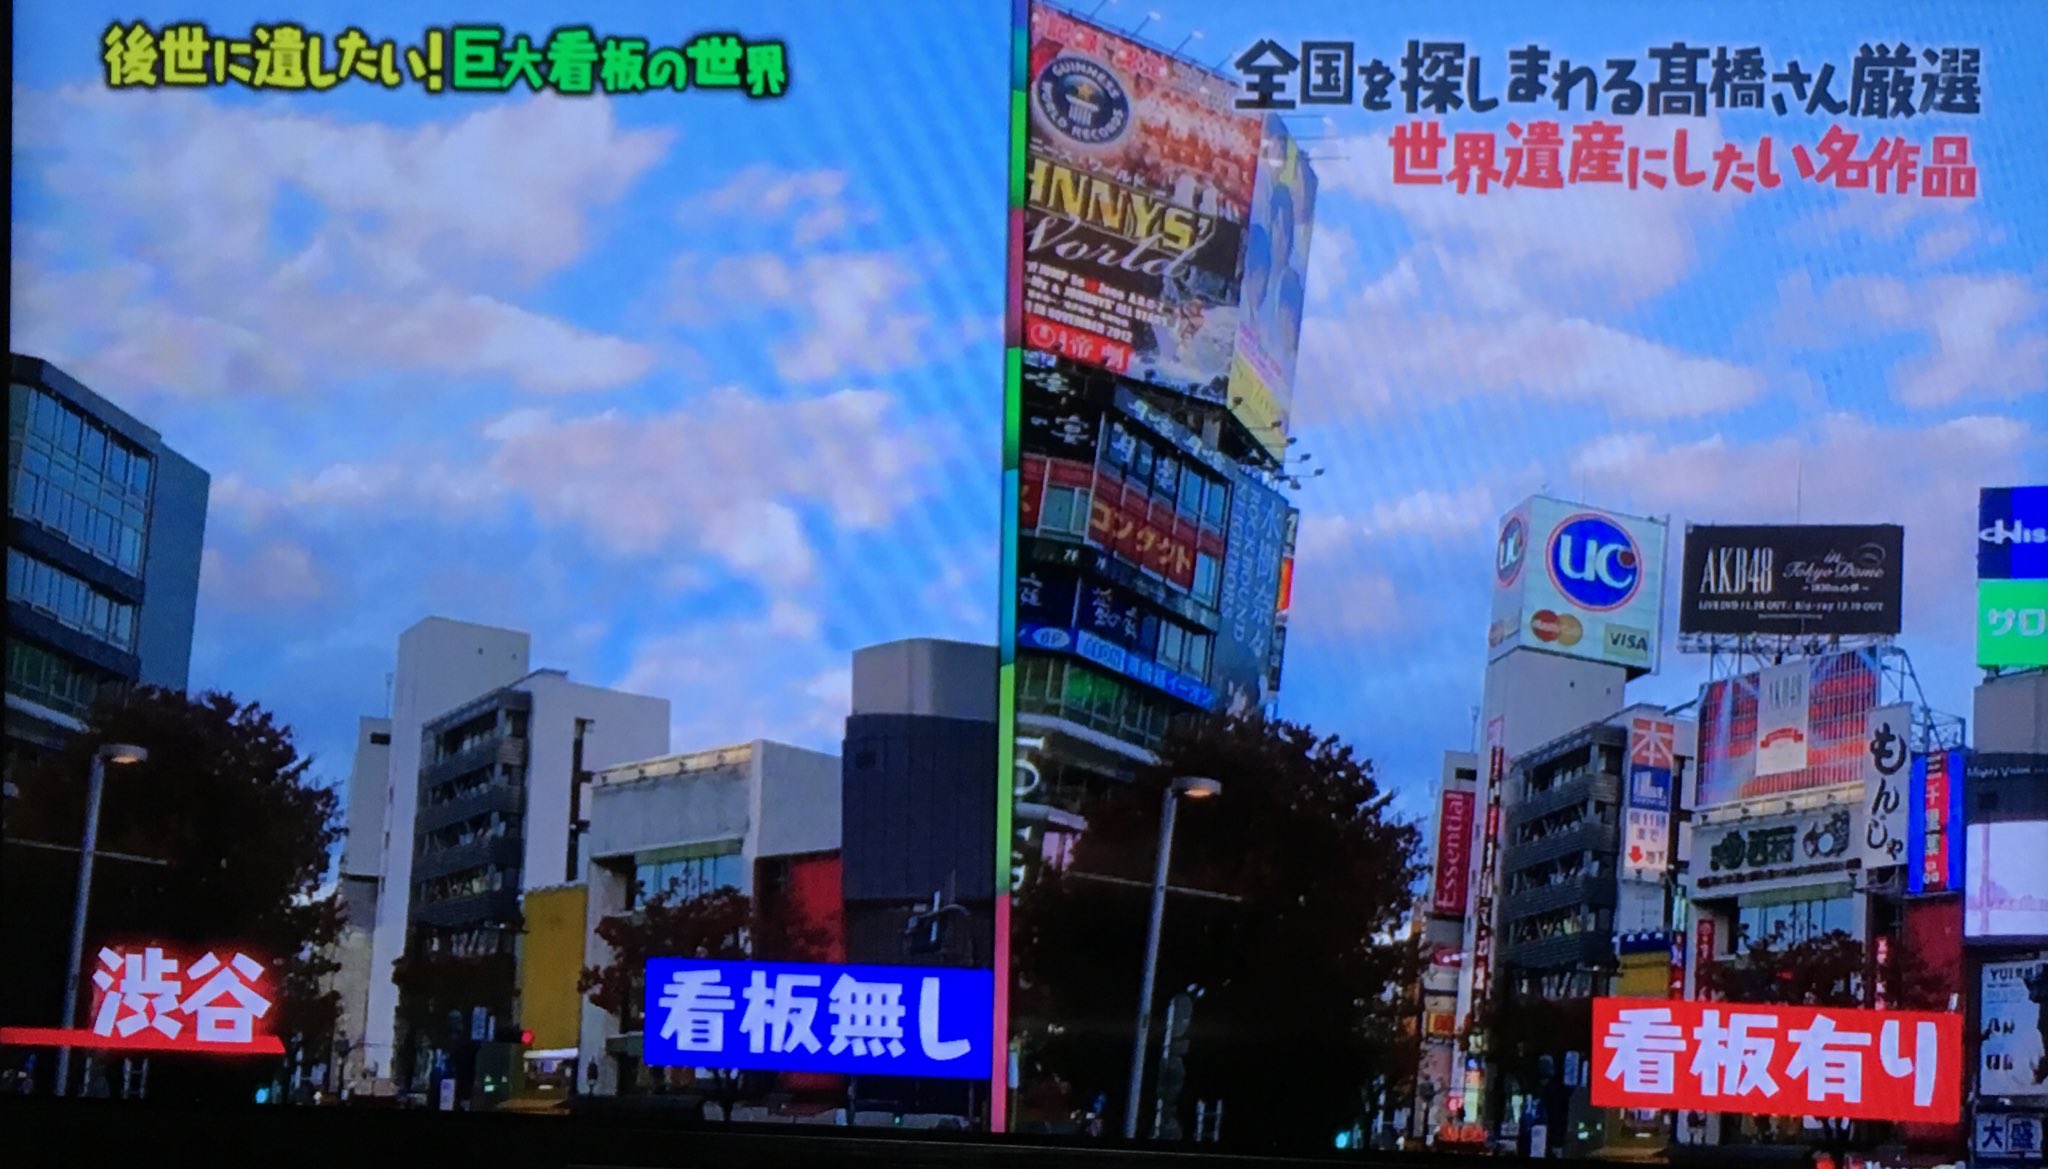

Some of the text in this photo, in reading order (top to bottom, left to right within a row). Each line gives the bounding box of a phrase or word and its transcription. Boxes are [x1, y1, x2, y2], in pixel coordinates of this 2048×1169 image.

[1052, 61, 1120, 99] GUINNESS
[1041, 81, 1068, 128] WORLD
[1071, 109, 1124, 140] RECORDS
[1092, 500, 1191, 574] コンタクト
[1699, 547, 1774, 593] AKB48
[1782, 561, 1886, 583] Tokyo Dome
[1609, 632, 1649, 652] VISA
[1632, 721, 1673, 767] 本
[1867, 722, 1906, 860] もんじゃ
[1437, 793, 1464, 909] Essential
